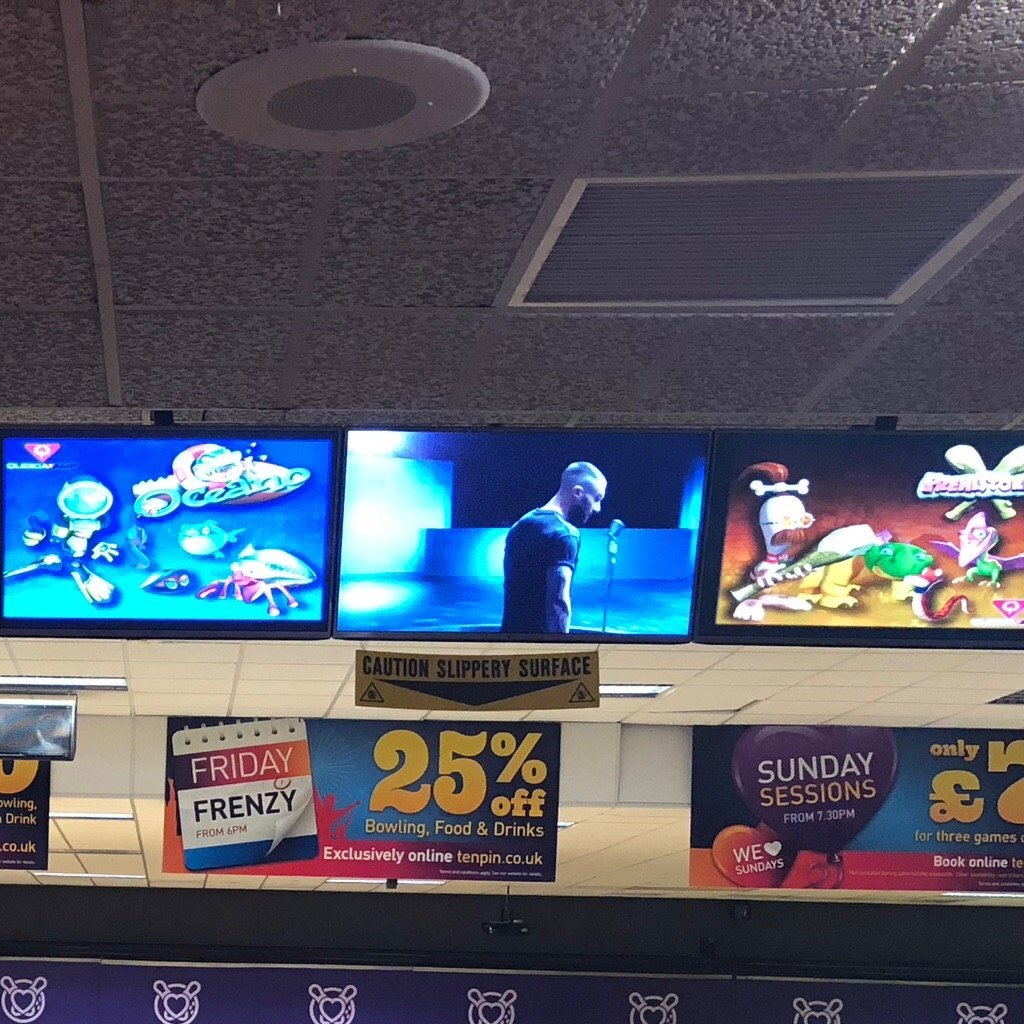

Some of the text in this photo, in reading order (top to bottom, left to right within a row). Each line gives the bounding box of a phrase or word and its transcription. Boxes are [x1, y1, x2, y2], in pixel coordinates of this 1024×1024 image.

[362, 655, 591, 679] CAUTION SLIPPERY SURFACE
[929, 739, 980, 762] only
[191, 746, 293, 784] FRIDAY
[369, 729, 547, 815] 25%
[758, 752, 874, 784] SUNDAY
[490, 788, 547, 817] off
[760, 779, 876, 807] SESSIONS
[193, 789, 297, 822] FRENZY
[783, 809, 855, 823] FROM 7.30PM
[5, 813, 37, 825] Drink
[365, 819, 544, 837] Bowling, Food & Drinks
[196, 824, 248, 839] FROM 6PM
[915, 830, 933, 841] for
[936, 830, 970, 842] three
[974, 833, 1017, 845] games
[323, 846, 543, 867] Exclusively online tenpin.co.uk
[733, 844, 764, 863] WE
[933, 855, 966, 867] Book
[968, 856, 1008, 868] online
[735, 858, 784, 875] SUNDAYS
